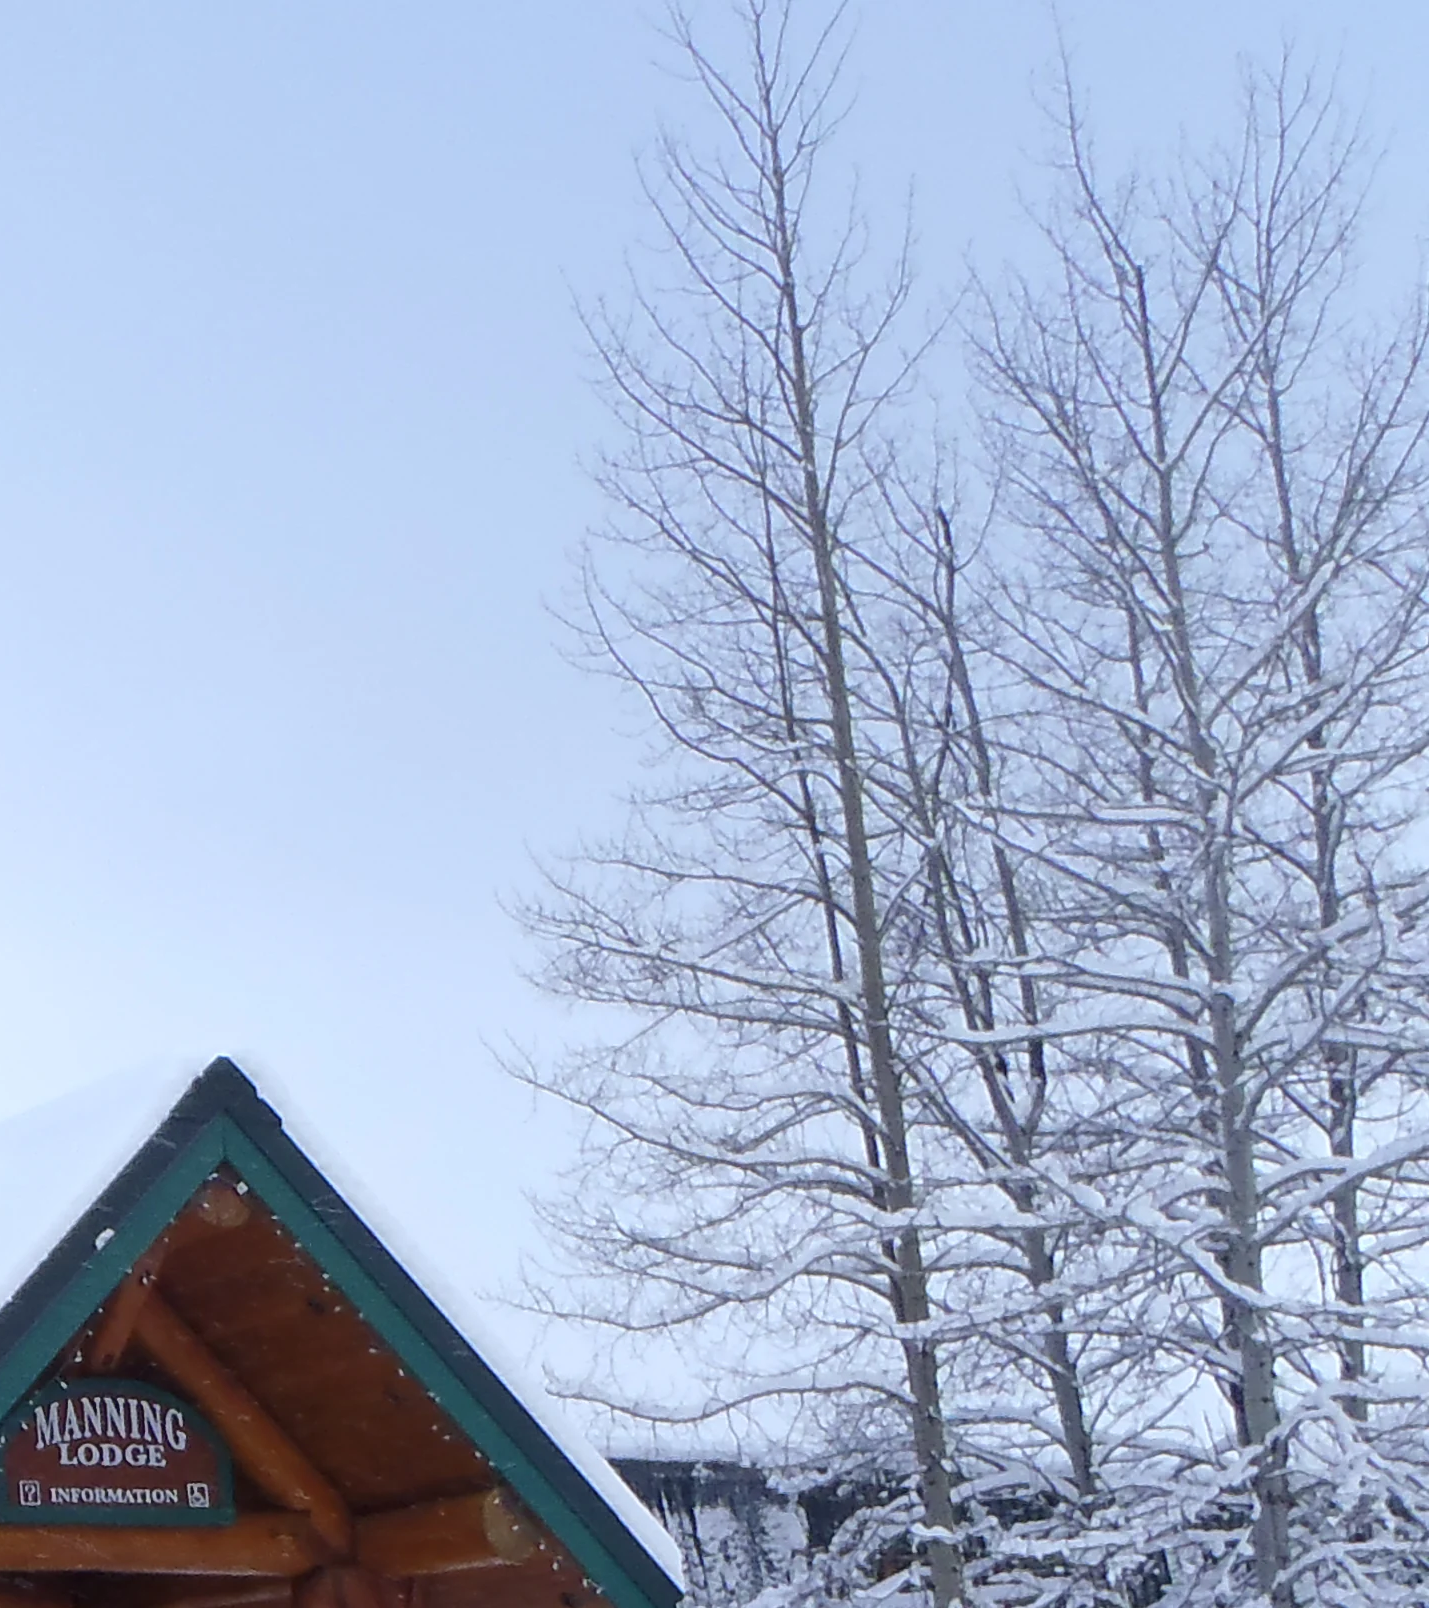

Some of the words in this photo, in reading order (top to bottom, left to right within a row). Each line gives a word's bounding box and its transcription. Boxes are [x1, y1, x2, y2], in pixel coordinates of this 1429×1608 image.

[33, 1396, 188, 1451] MANNING
[58, 1443, 168, 1468] LODGE
[48, 1486, 180, 1505] INFORMATION
